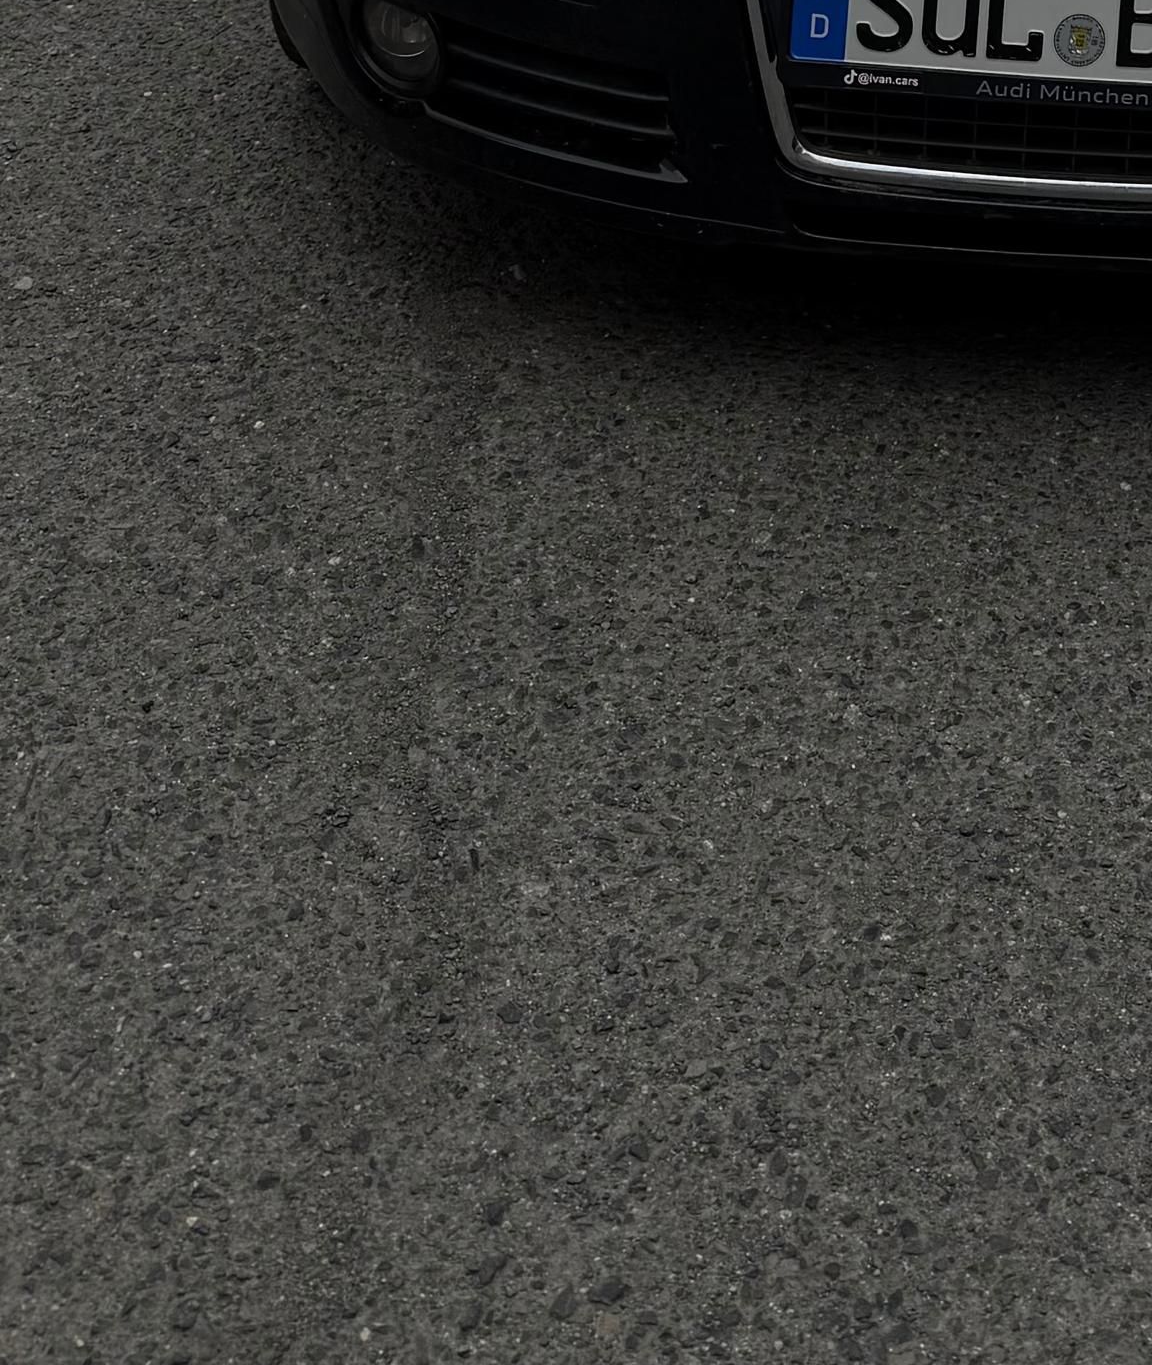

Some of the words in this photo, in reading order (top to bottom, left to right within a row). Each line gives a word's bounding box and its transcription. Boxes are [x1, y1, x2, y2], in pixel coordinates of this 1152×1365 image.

[809, 13, 831, 40] D
[975, 80, 1031, 100] Audi
[1039, 84, 1149, 107] München
